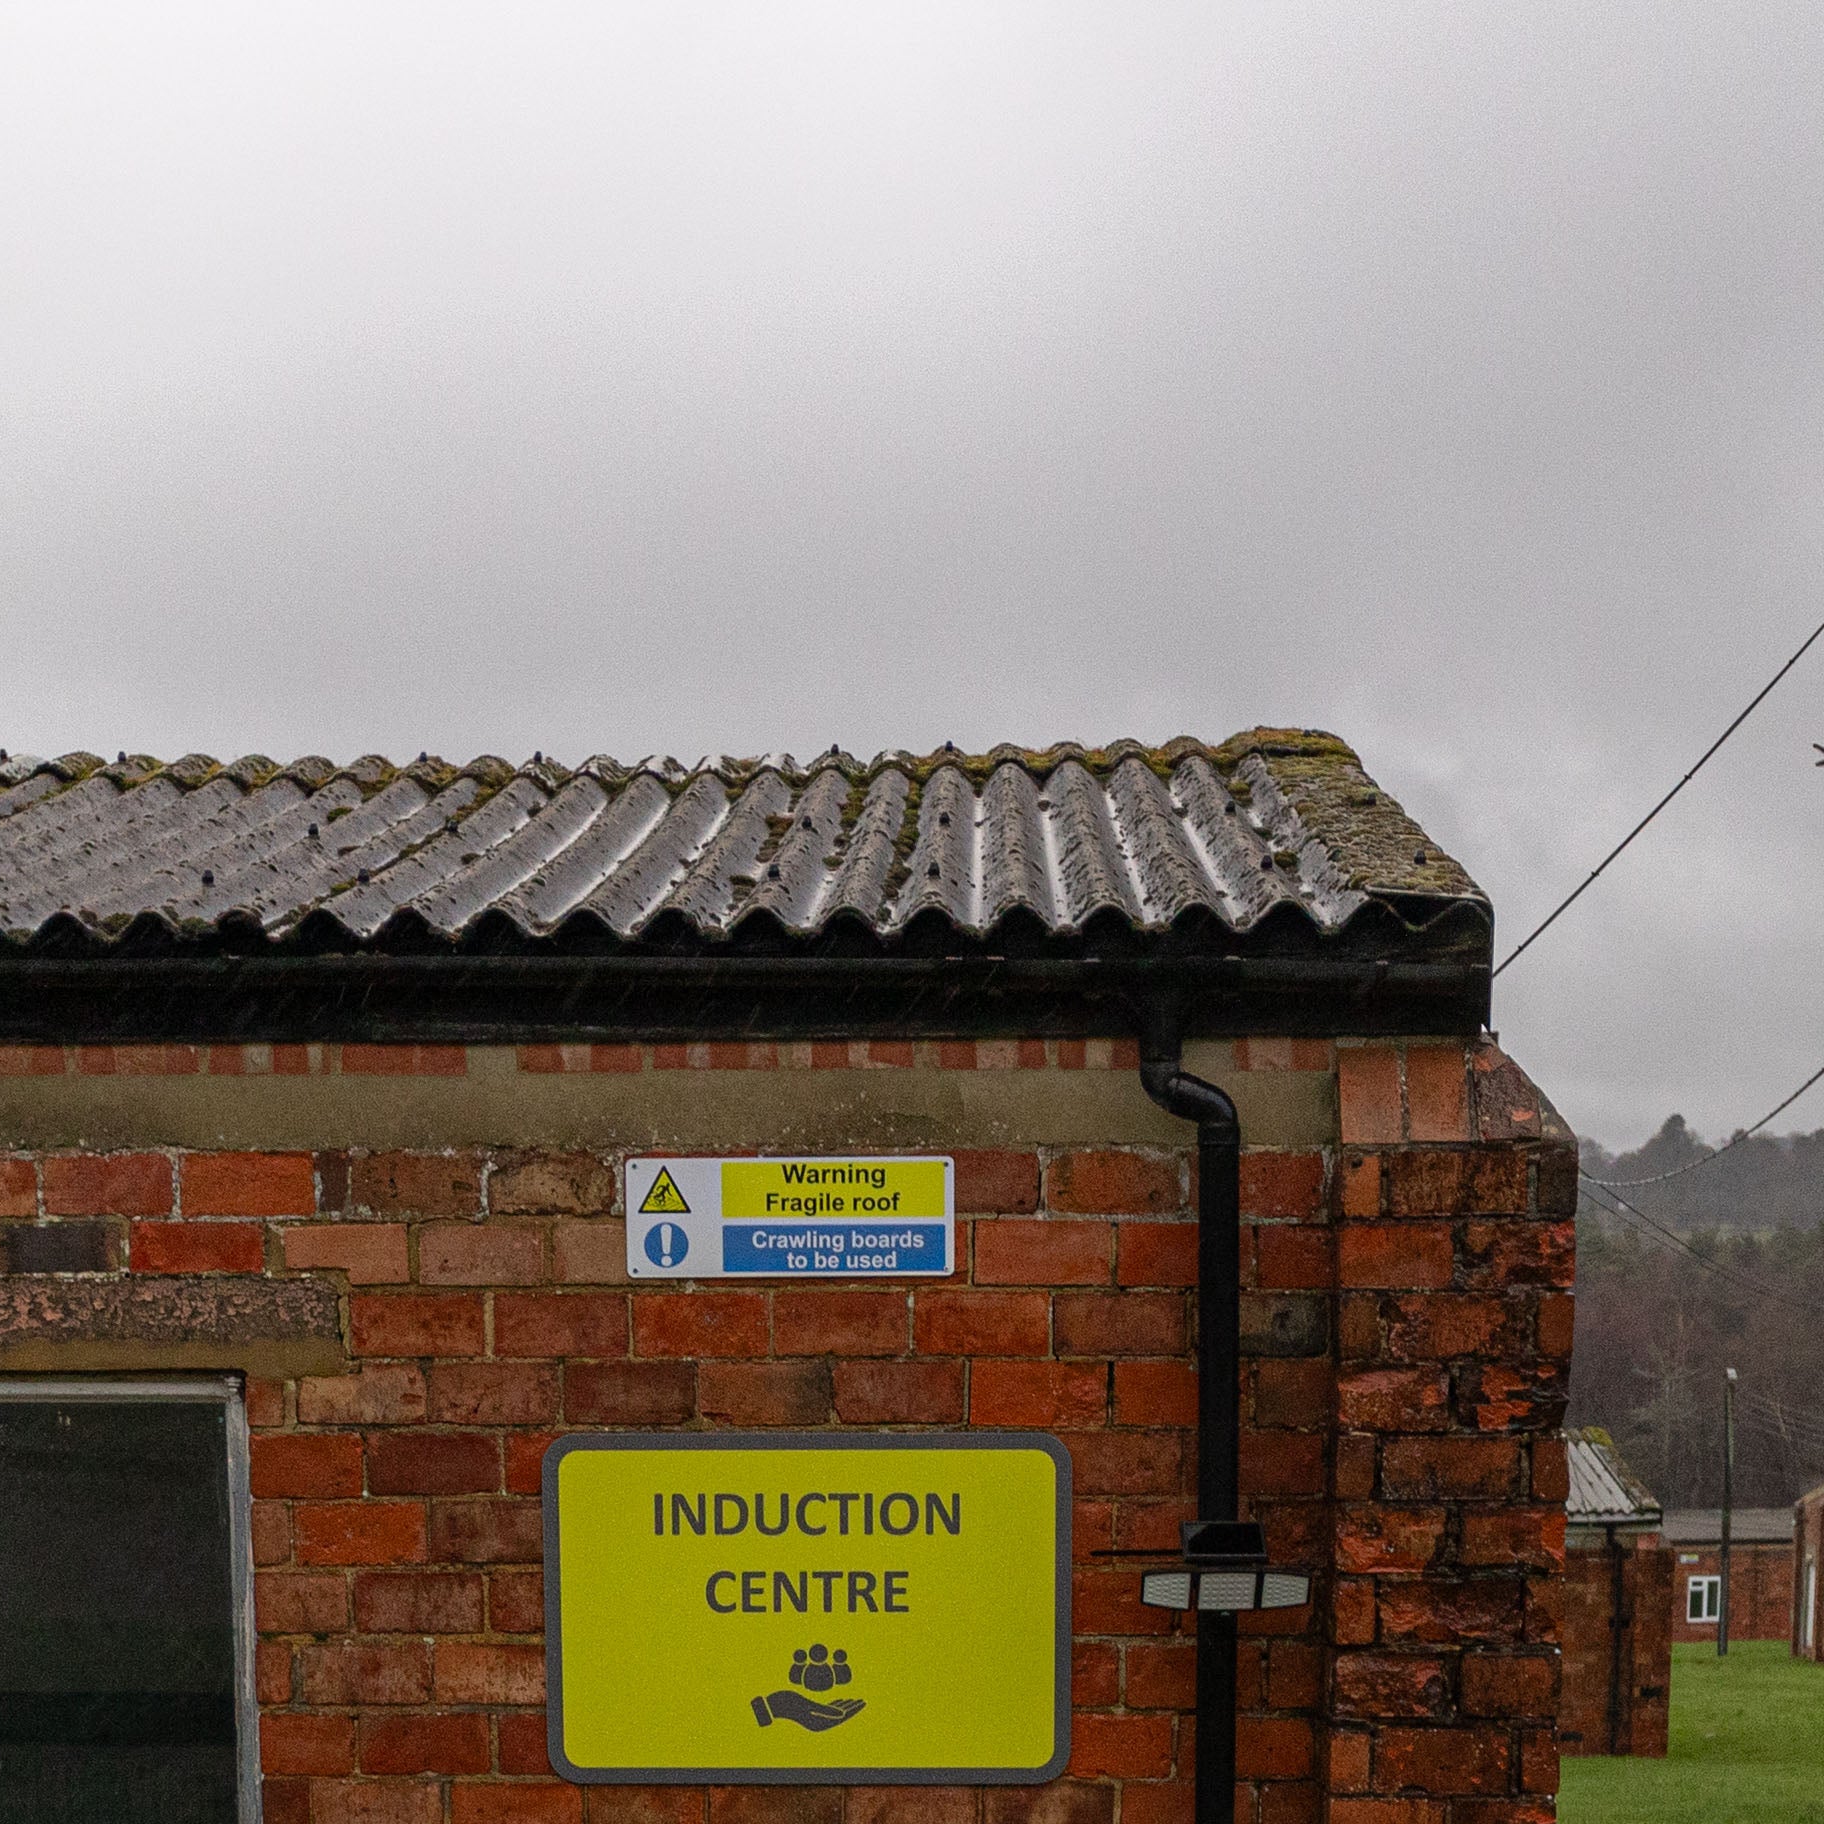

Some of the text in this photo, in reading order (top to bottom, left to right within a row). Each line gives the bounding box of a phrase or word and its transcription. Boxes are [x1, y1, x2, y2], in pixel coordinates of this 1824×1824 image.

[781, 1163, 887, 1188] Warning
[765, 1192, 901, 1216] Fragile roof
[751, 1230, 925, 1252] Crawling boards
[786, 1251, 897, 1269] to be used
[652, 1491, 962, 1537] INDUCTION
[704, 1570, 911, 1614] CENTRE
